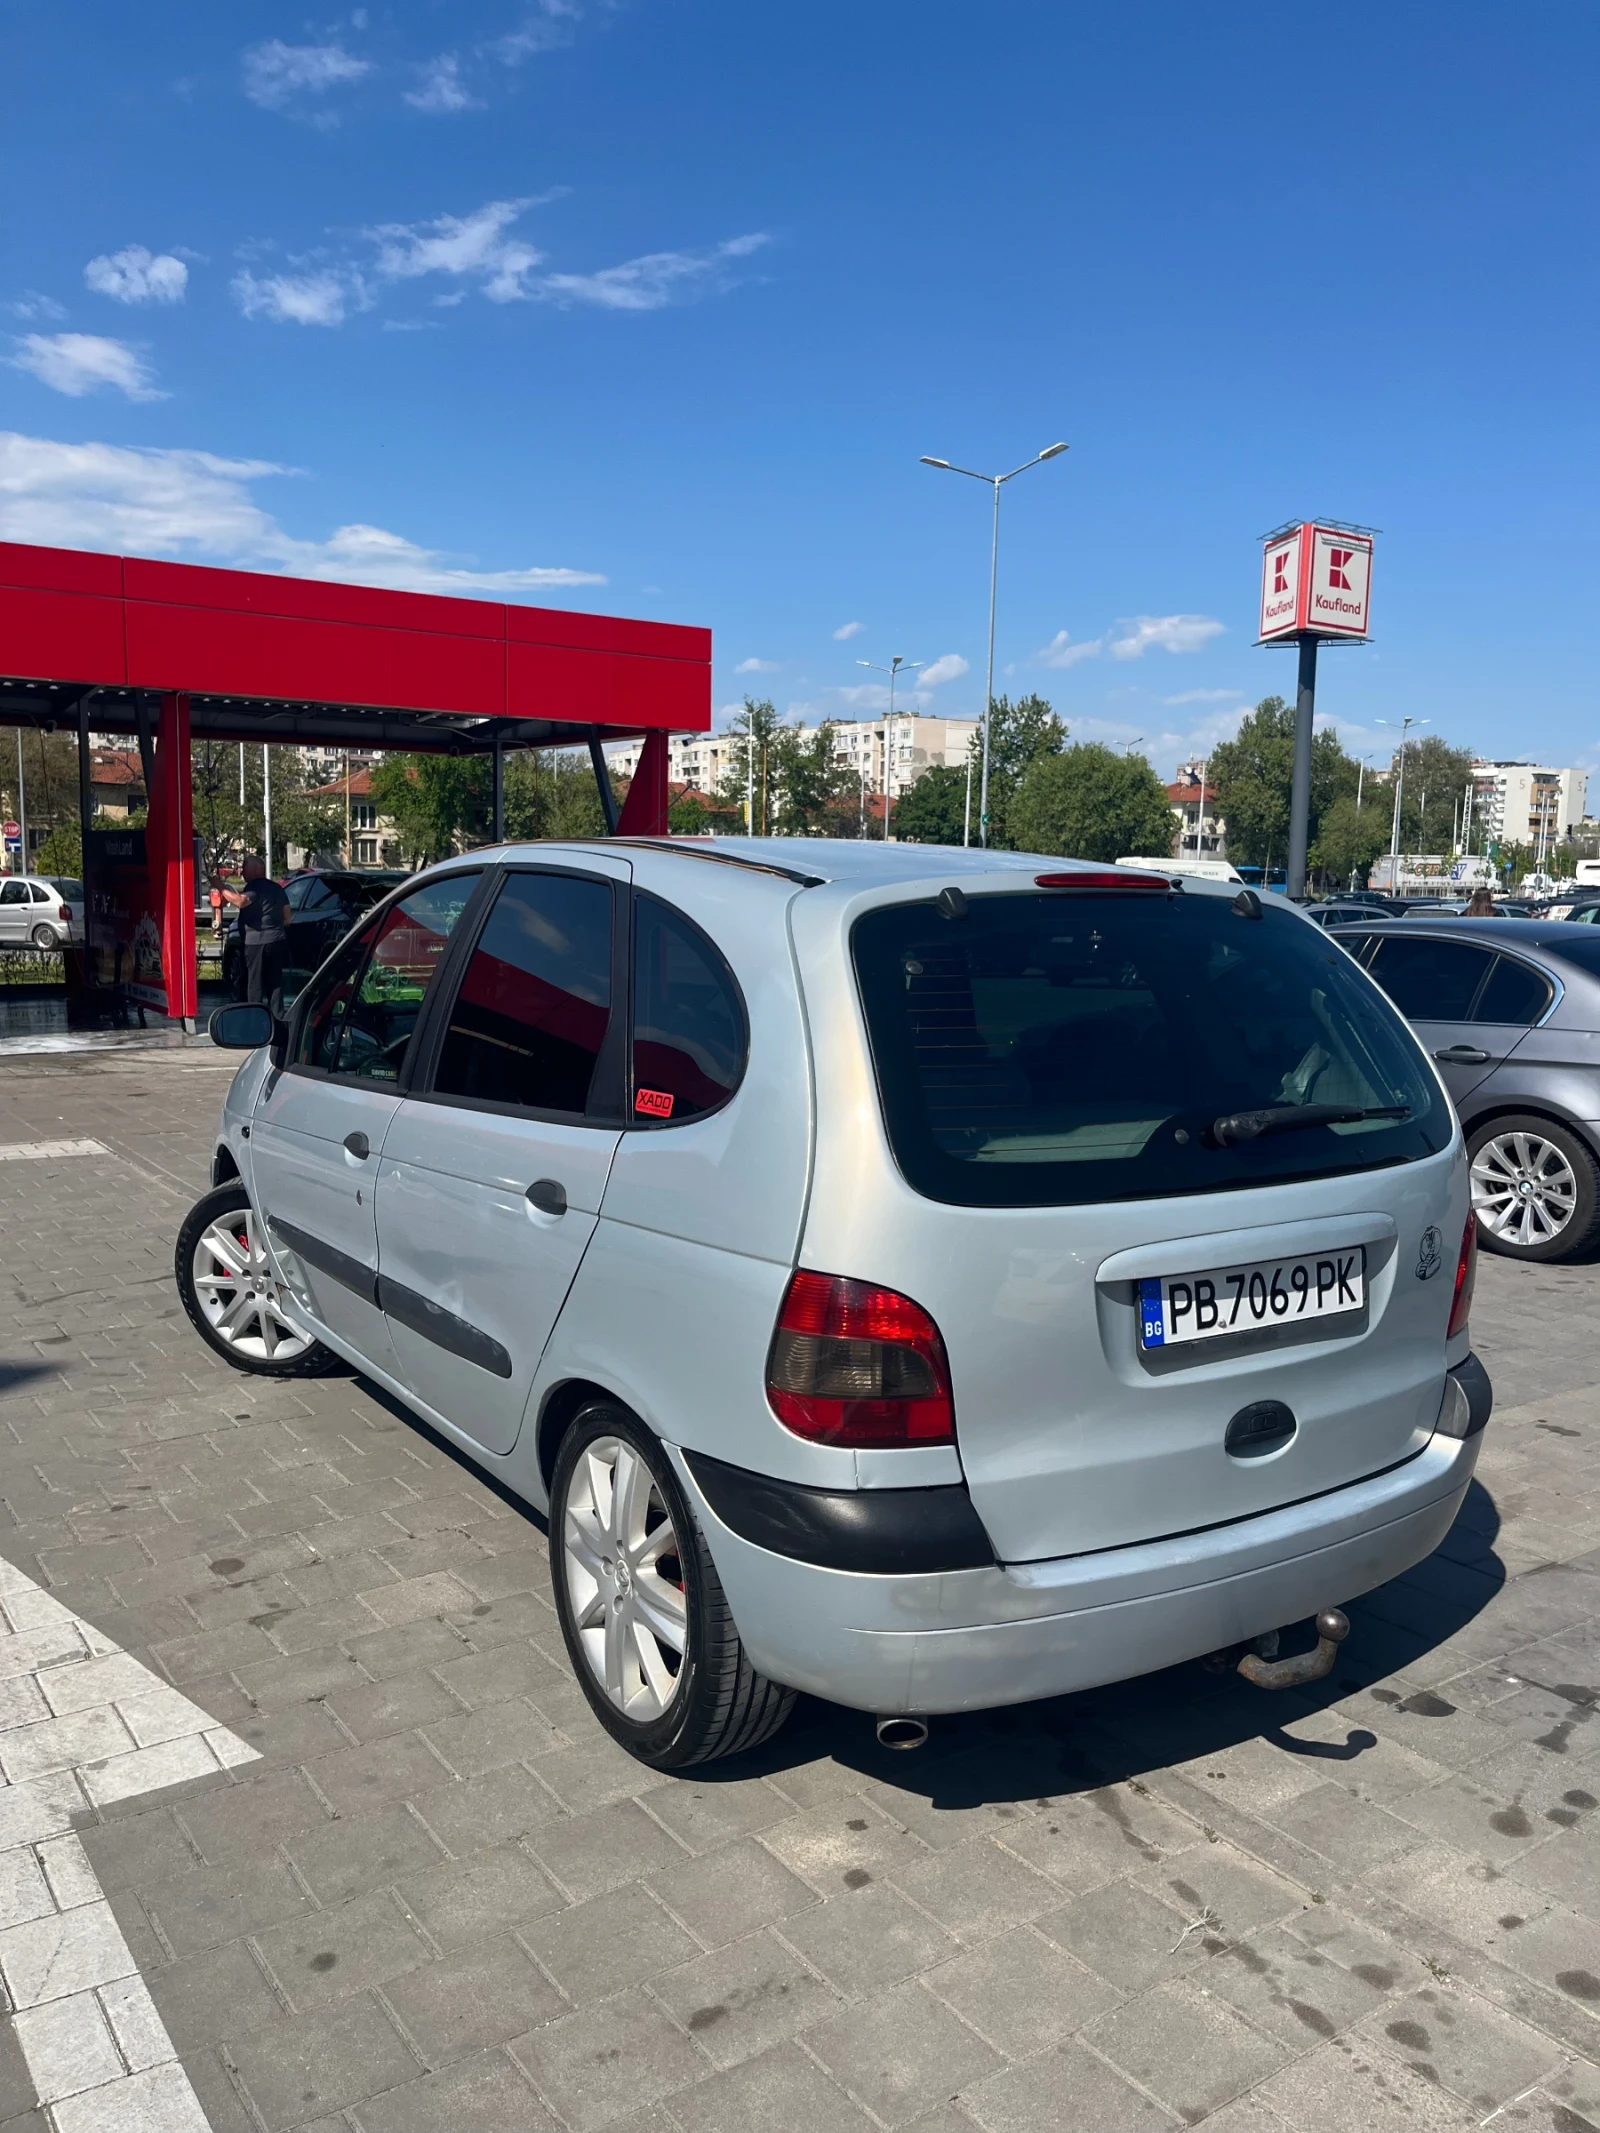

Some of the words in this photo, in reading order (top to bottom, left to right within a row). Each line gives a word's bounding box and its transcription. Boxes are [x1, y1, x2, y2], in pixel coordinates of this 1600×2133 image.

[1266, 596, 1294, 618] Kaufland
[1315, 594, 1361, 615] Kaufland
[638, 1091, 671, 1109] XADO
[1144, 1320, 1163, 1338] BG
